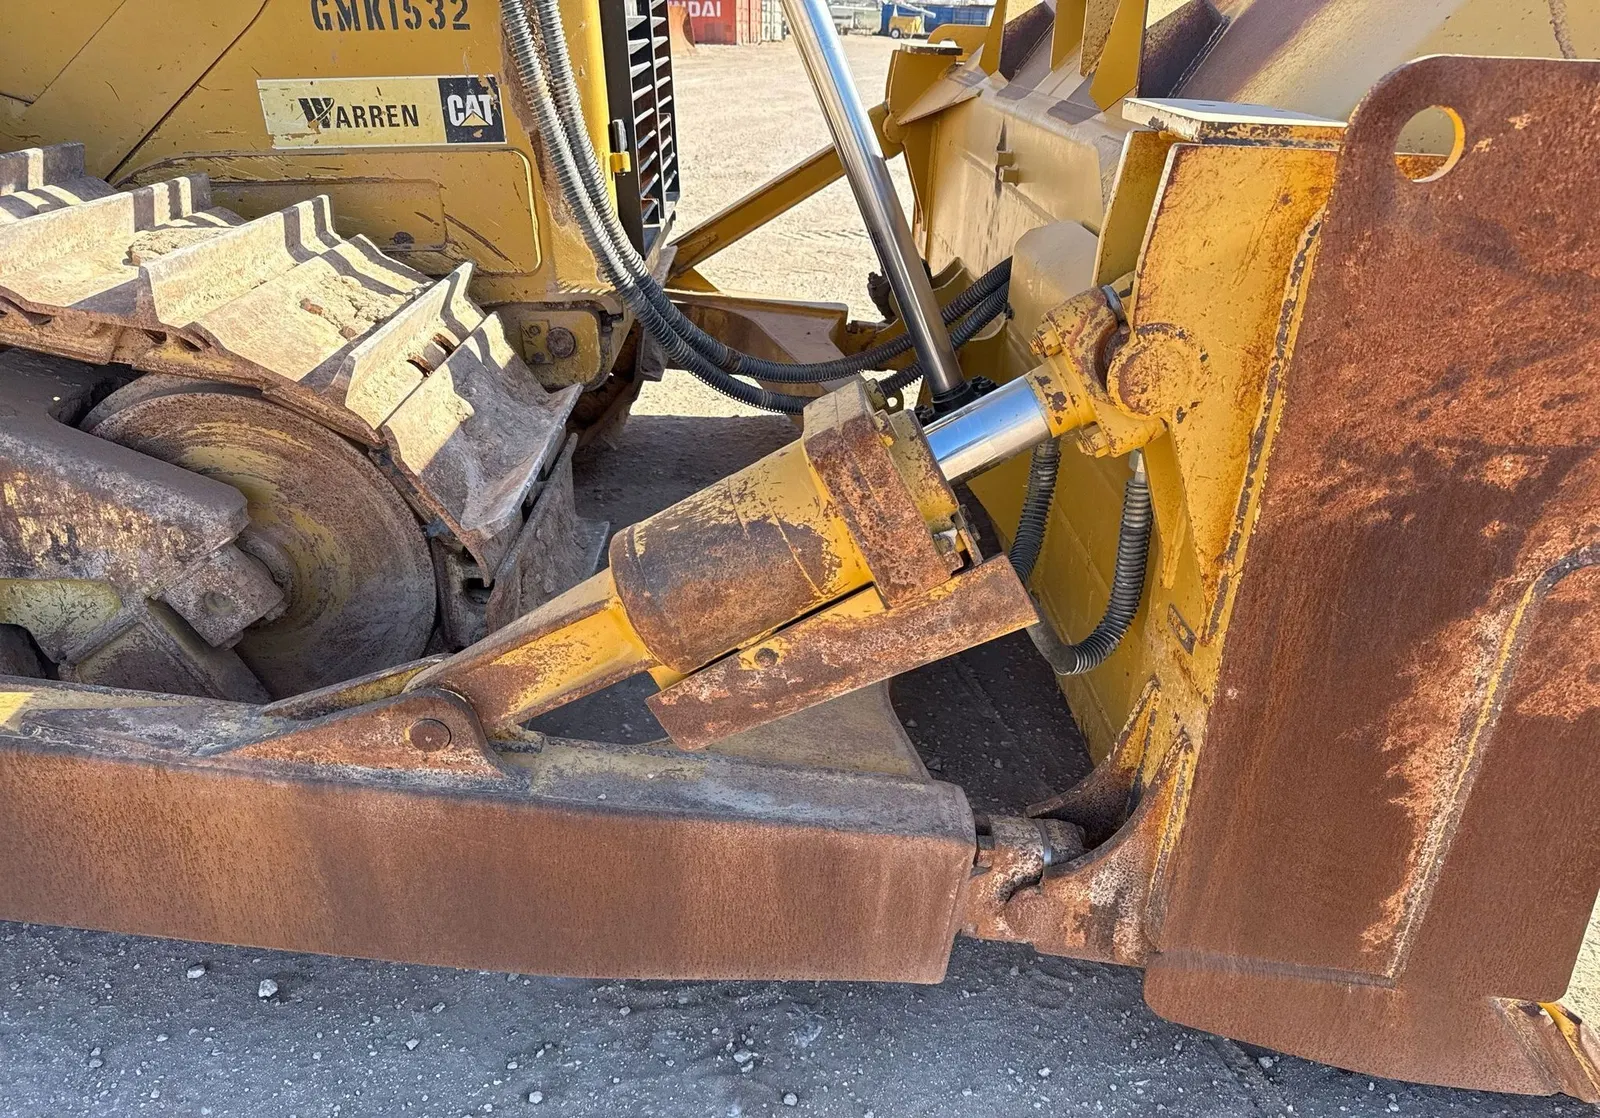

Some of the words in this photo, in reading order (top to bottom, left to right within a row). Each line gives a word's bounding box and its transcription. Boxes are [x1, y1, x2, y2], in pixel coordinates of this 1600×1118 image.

[668, 0, 721, 17] DAI
[298, 97, 420, 129] WARREN
[446, 94, 494, 127] CAT
